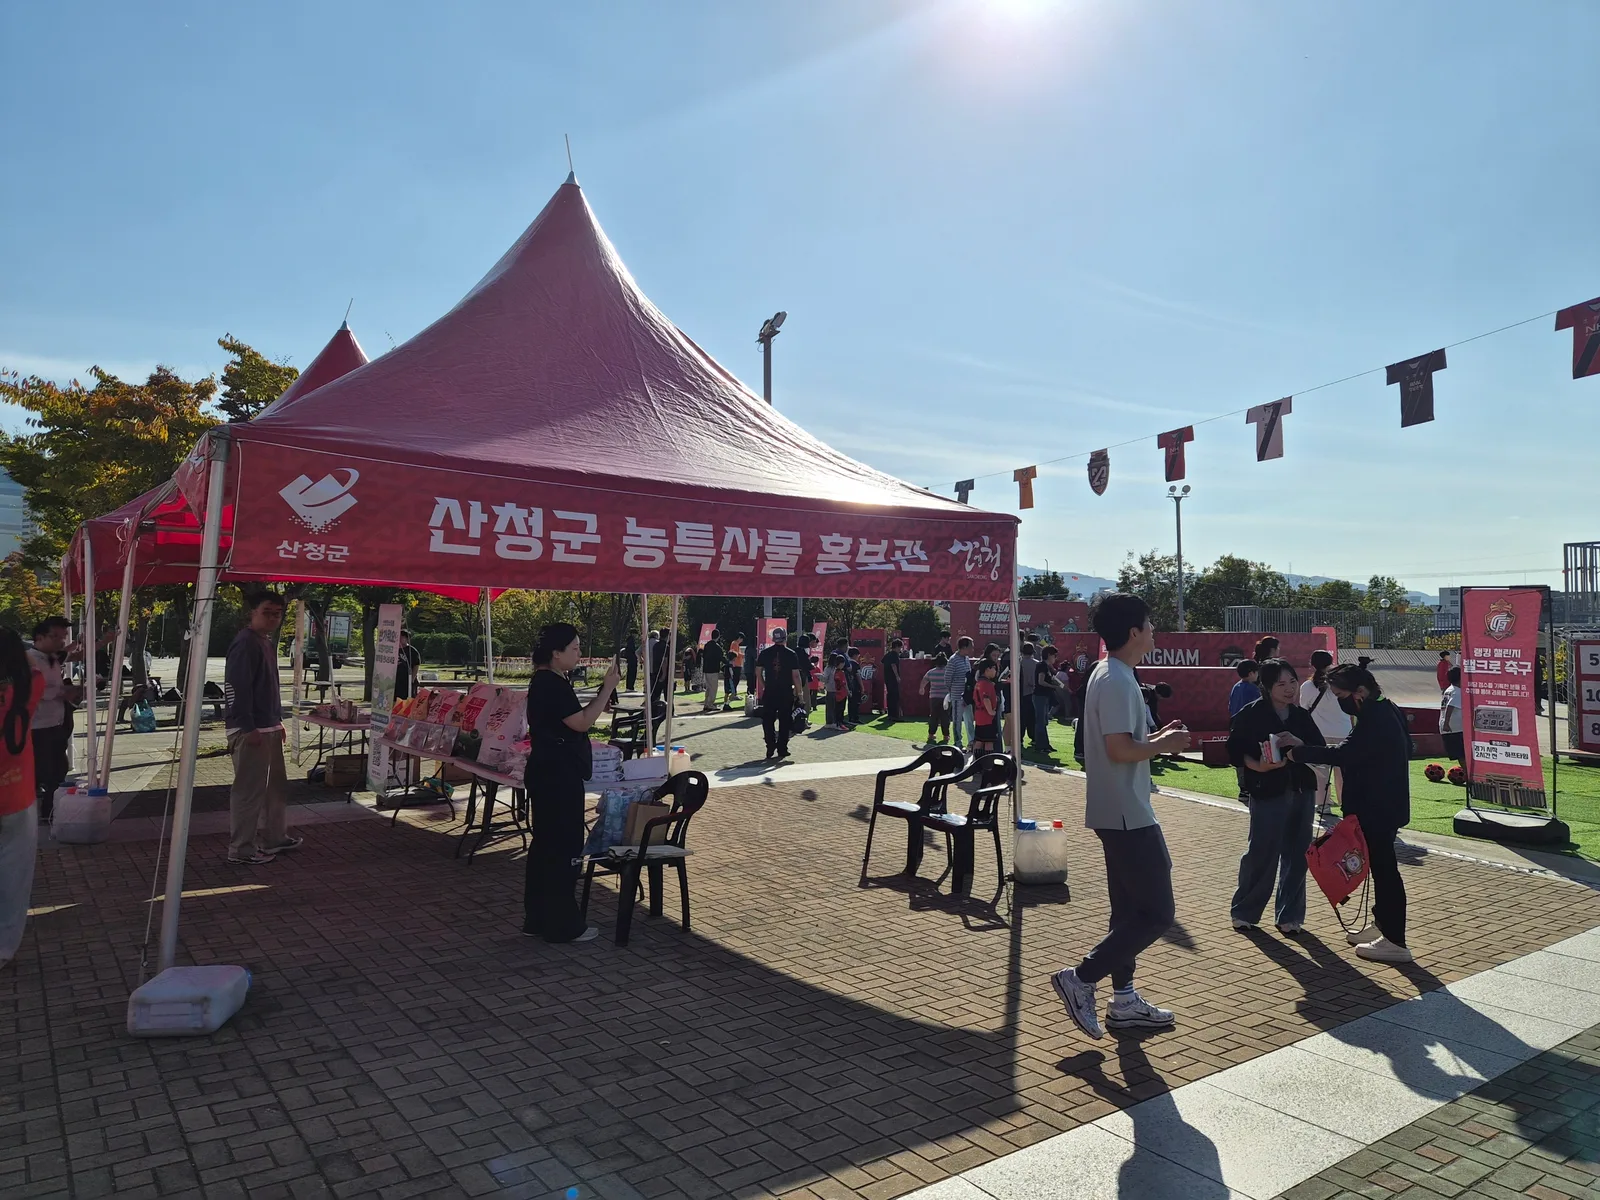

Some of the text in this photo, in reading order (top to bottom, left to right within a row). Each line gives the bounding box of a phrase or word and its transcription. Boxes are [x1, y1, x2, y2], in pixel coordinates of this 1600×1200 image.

[428, 496, 931, 576] 산청군 농특산물 홍보관
[276, 539, 350, 563] 산청군
[1473, 647, 1521, 658] 랭킹 챌린지
[1504, 660, 1532, 676] 축구
[1504, 751, 1529, 760] 하프타임
